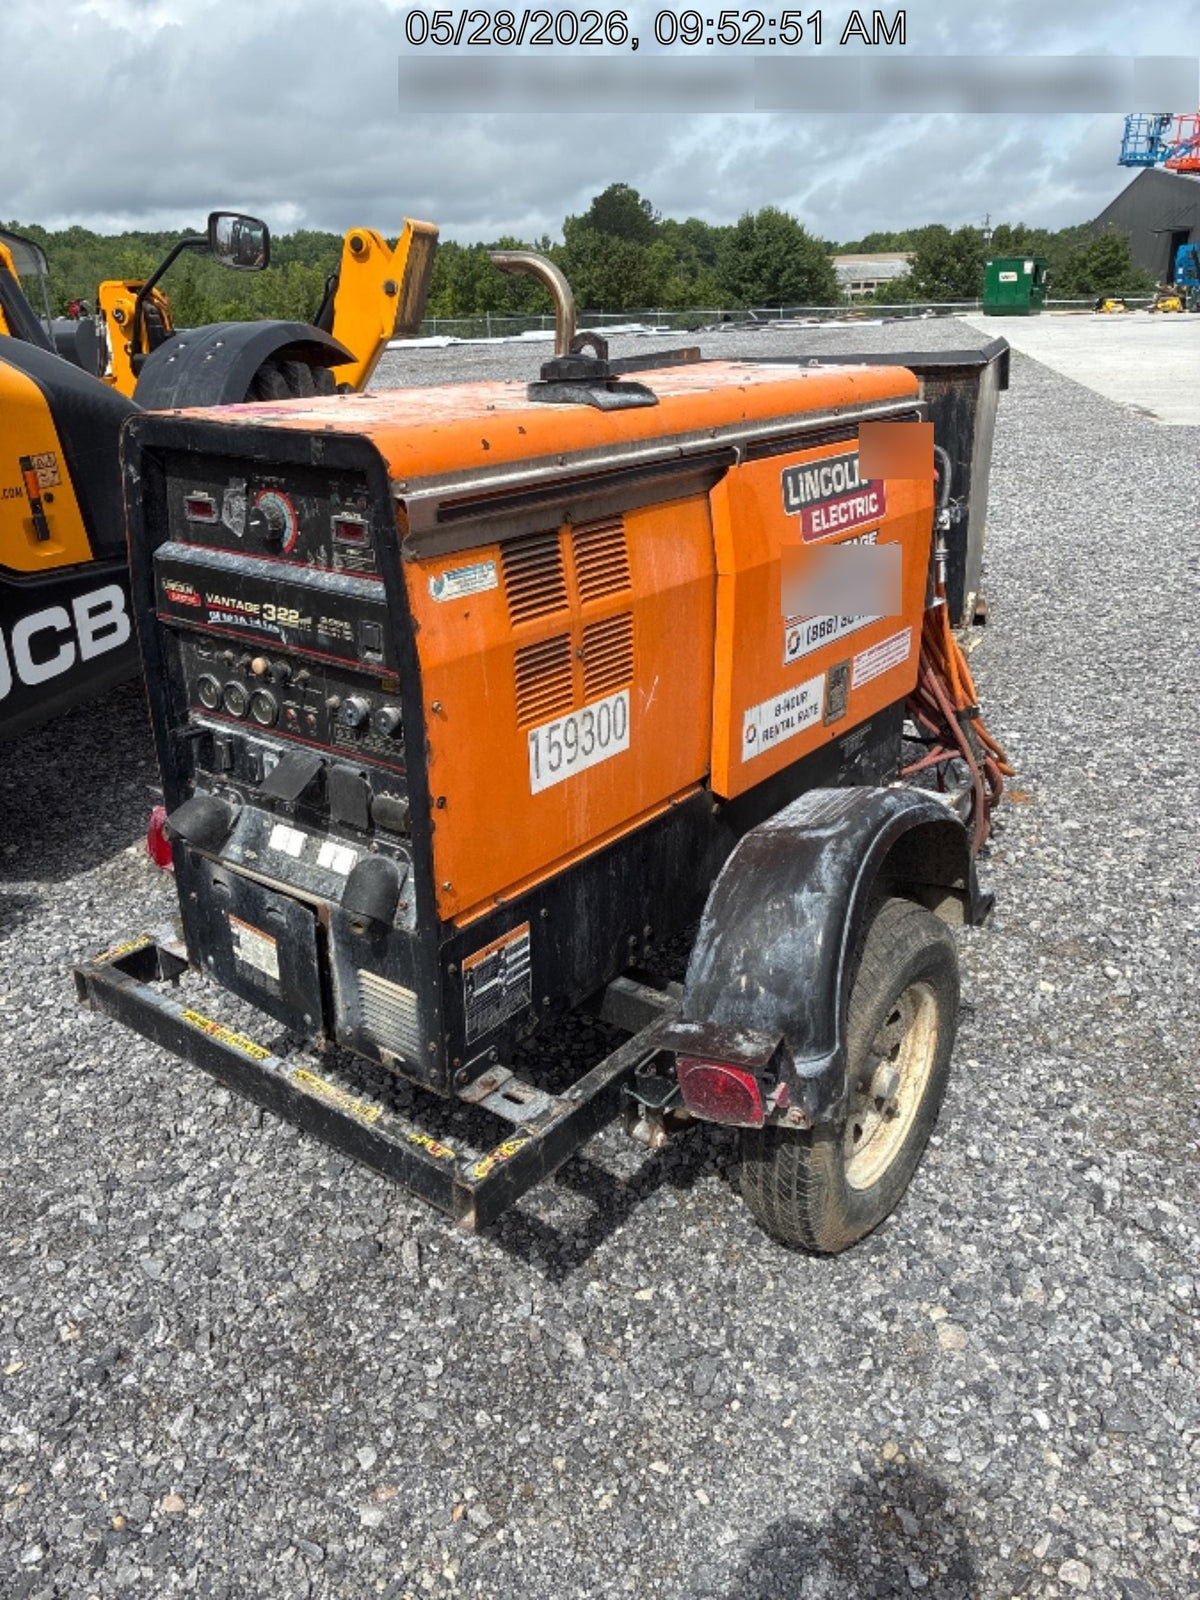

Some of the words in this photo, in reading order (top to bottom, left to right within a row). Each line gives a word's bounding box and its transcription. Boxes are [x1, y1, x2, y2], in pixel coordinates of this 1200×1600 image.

[811, 493, 879, 533] ELECTRIC
[205, 593, 260, 614] VANTAGE
[262, 603, 300, 623] 322
[806, 615, 838, 645] (888)
[530, 695, 628, 780] 159300
[762, 714, 795, 742] RENTAL
[798, 702, 819, 724] RATE
